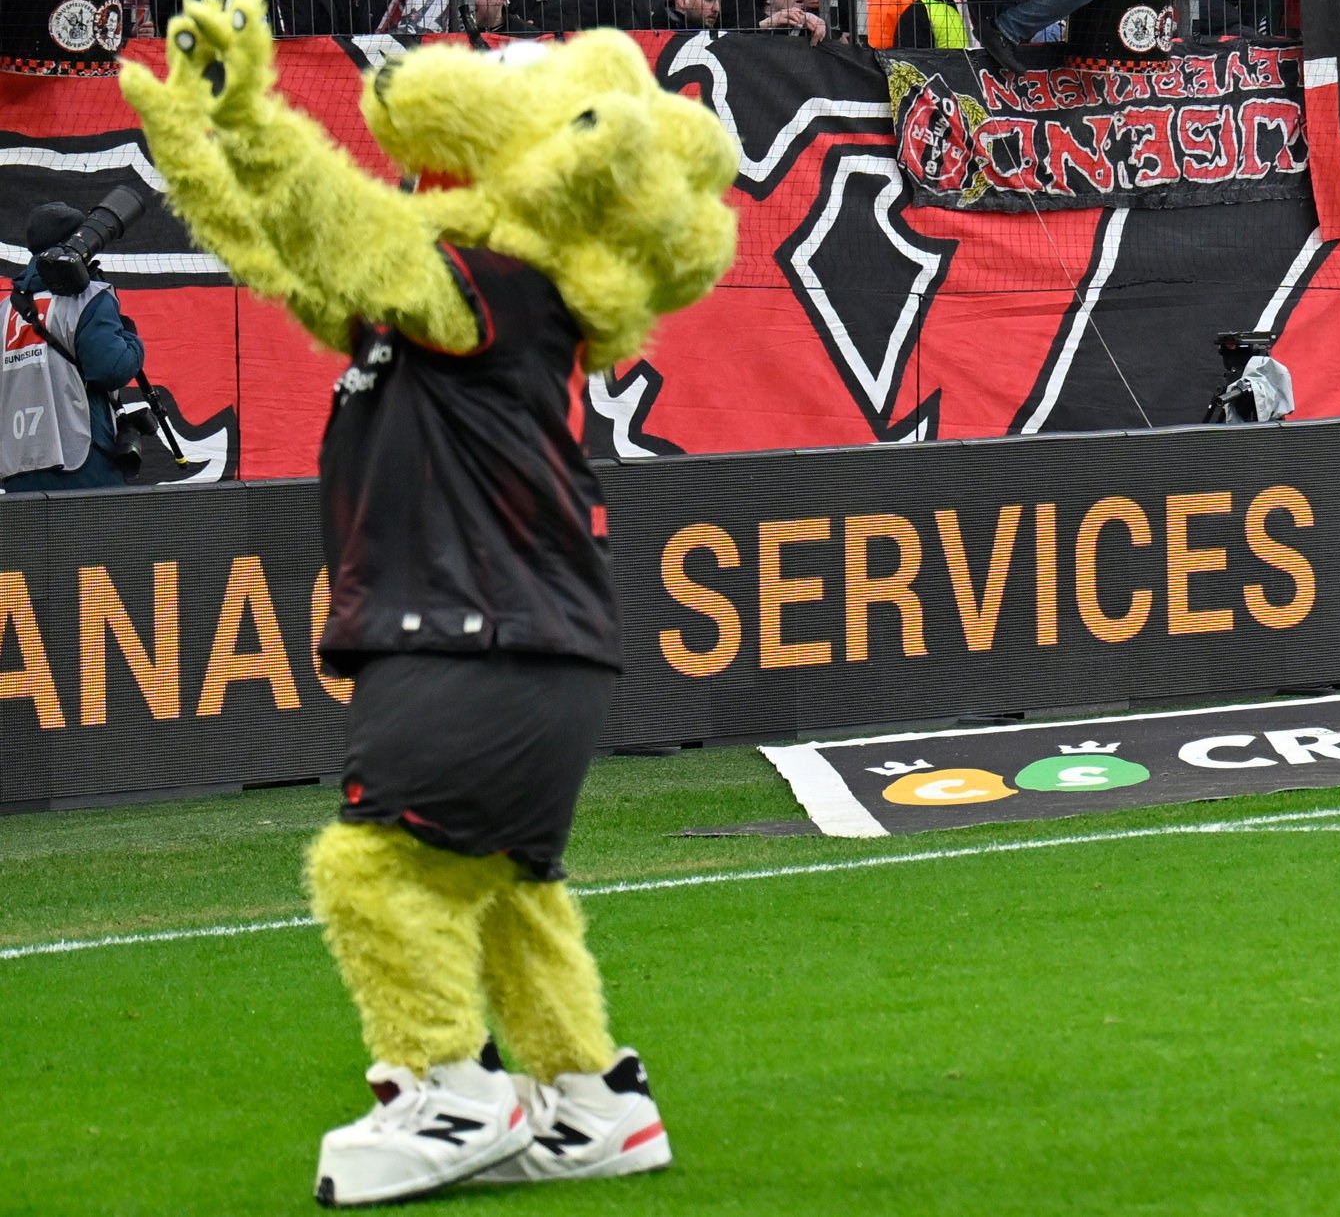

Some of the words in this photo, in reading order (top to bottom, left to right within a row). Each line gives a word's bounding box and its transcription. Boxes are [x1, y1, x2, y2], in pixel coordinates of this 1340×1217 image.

[971, 97, 1309, 197] UGEND
[12, 405, 45, 440] 07
[657, 484, 1316, 678] SERVICES
